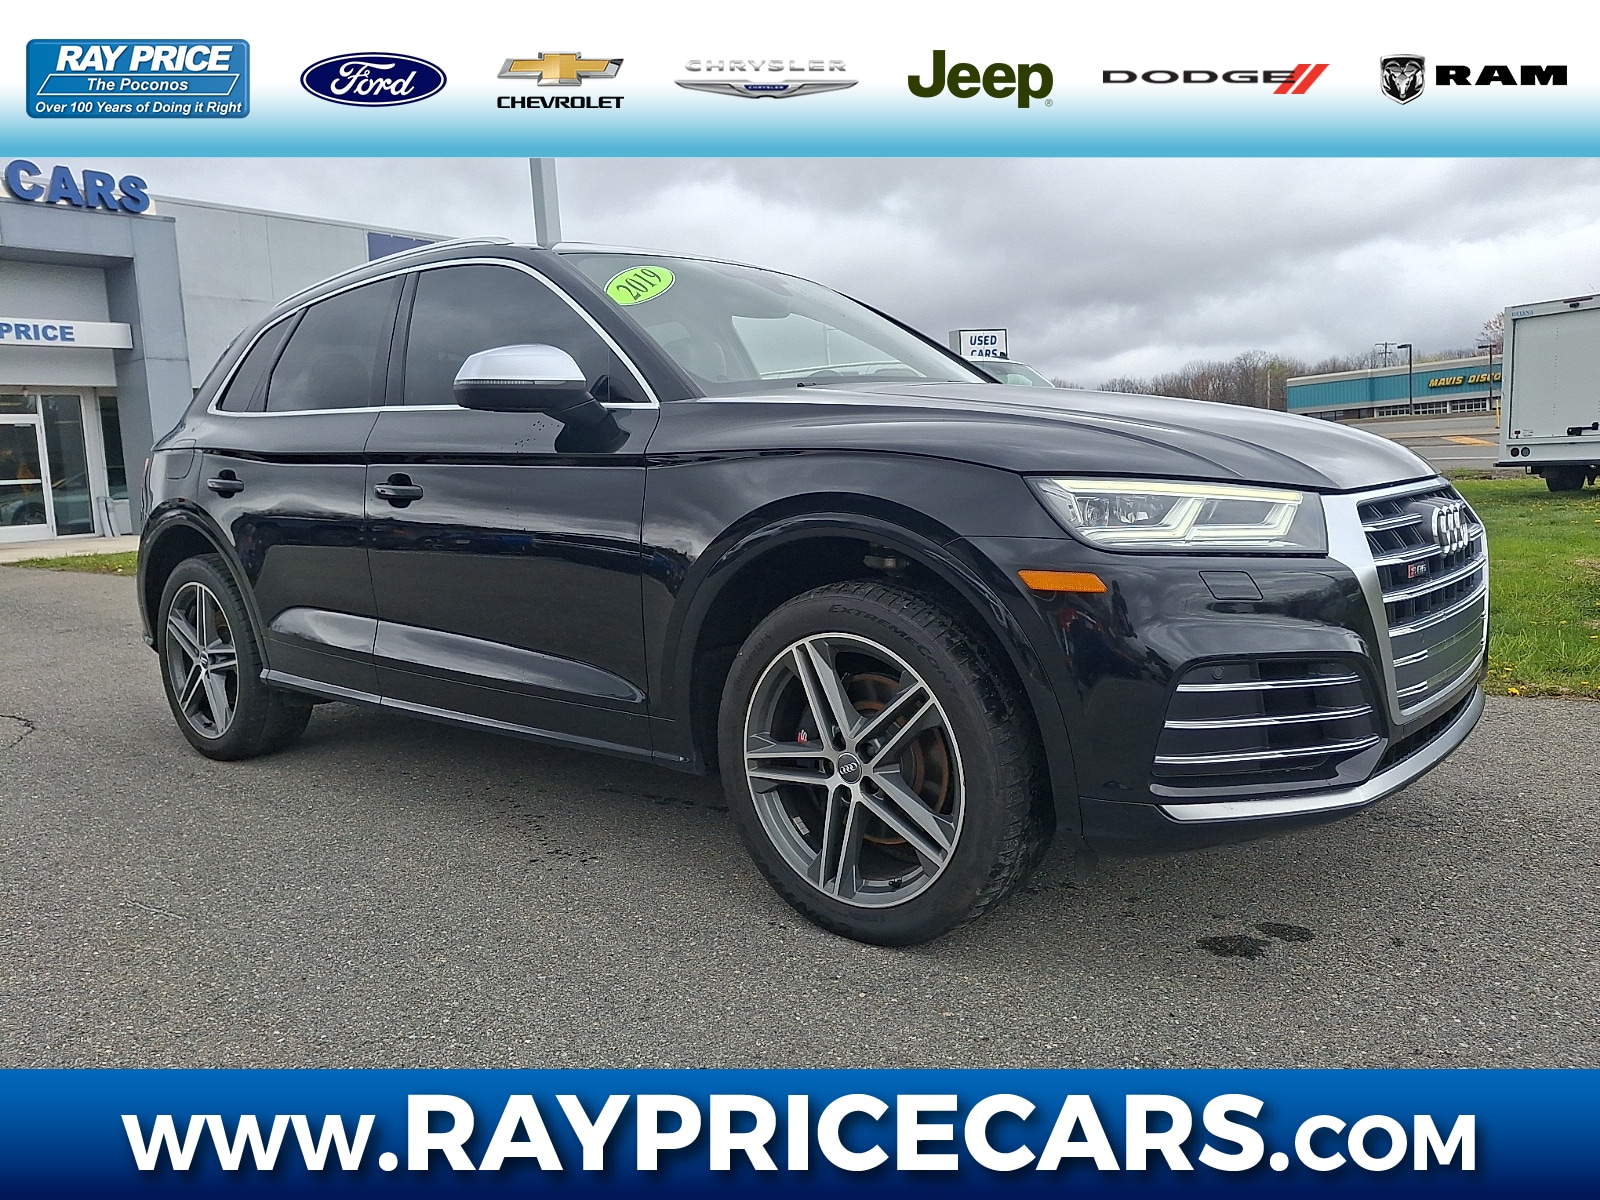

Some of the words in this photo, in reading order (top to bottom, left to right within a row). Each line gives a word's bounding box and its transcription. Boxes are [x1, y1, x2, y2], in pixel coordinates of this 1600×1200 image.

[5, 159, 151, 214] CARS
[616, 268, 662, 301] 2019
[0, 322, 76, 342] PRICE
[970, 335, 998, 346] USED
[1428, 376, 1464, 388] MAVIS
